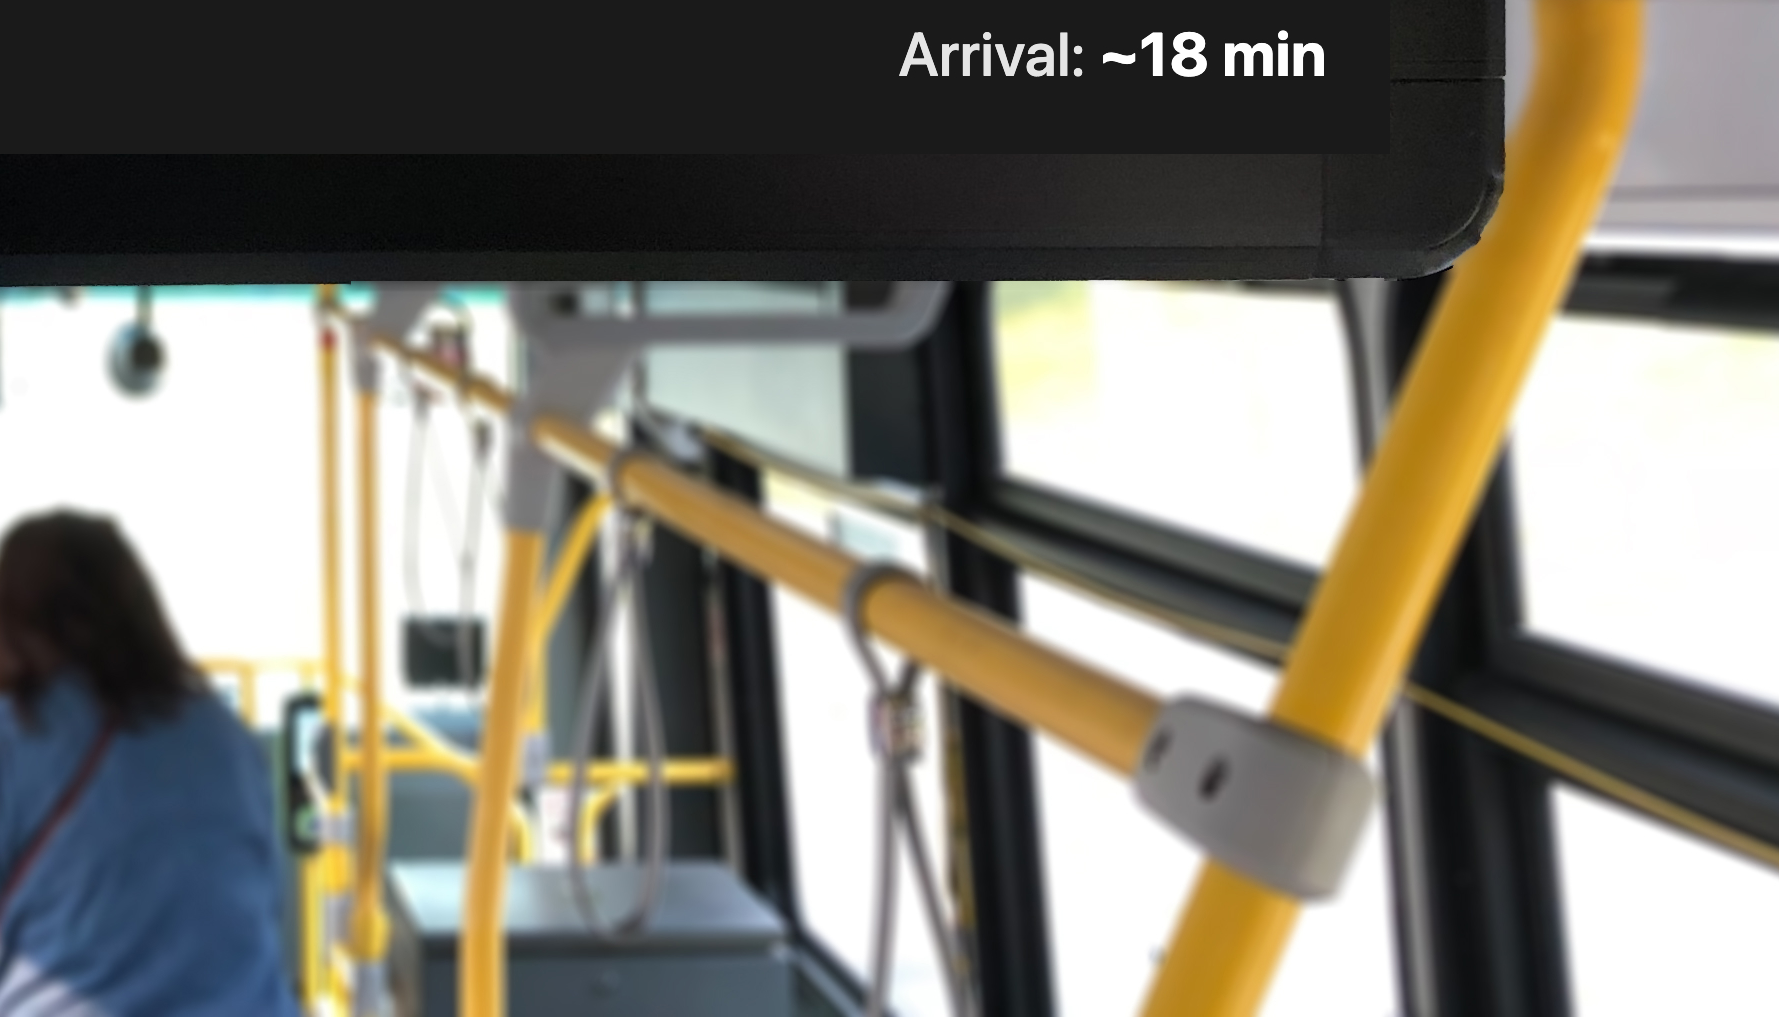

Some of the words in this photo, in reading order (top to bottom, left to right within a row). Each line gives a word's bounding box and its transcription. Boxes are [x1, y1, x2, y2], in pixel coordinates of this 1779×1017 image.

[899, 32, 1082, 77] Arrival:
[1103, 32, 1207, 77] ~18
[1225, 30, 1324, 76] min
